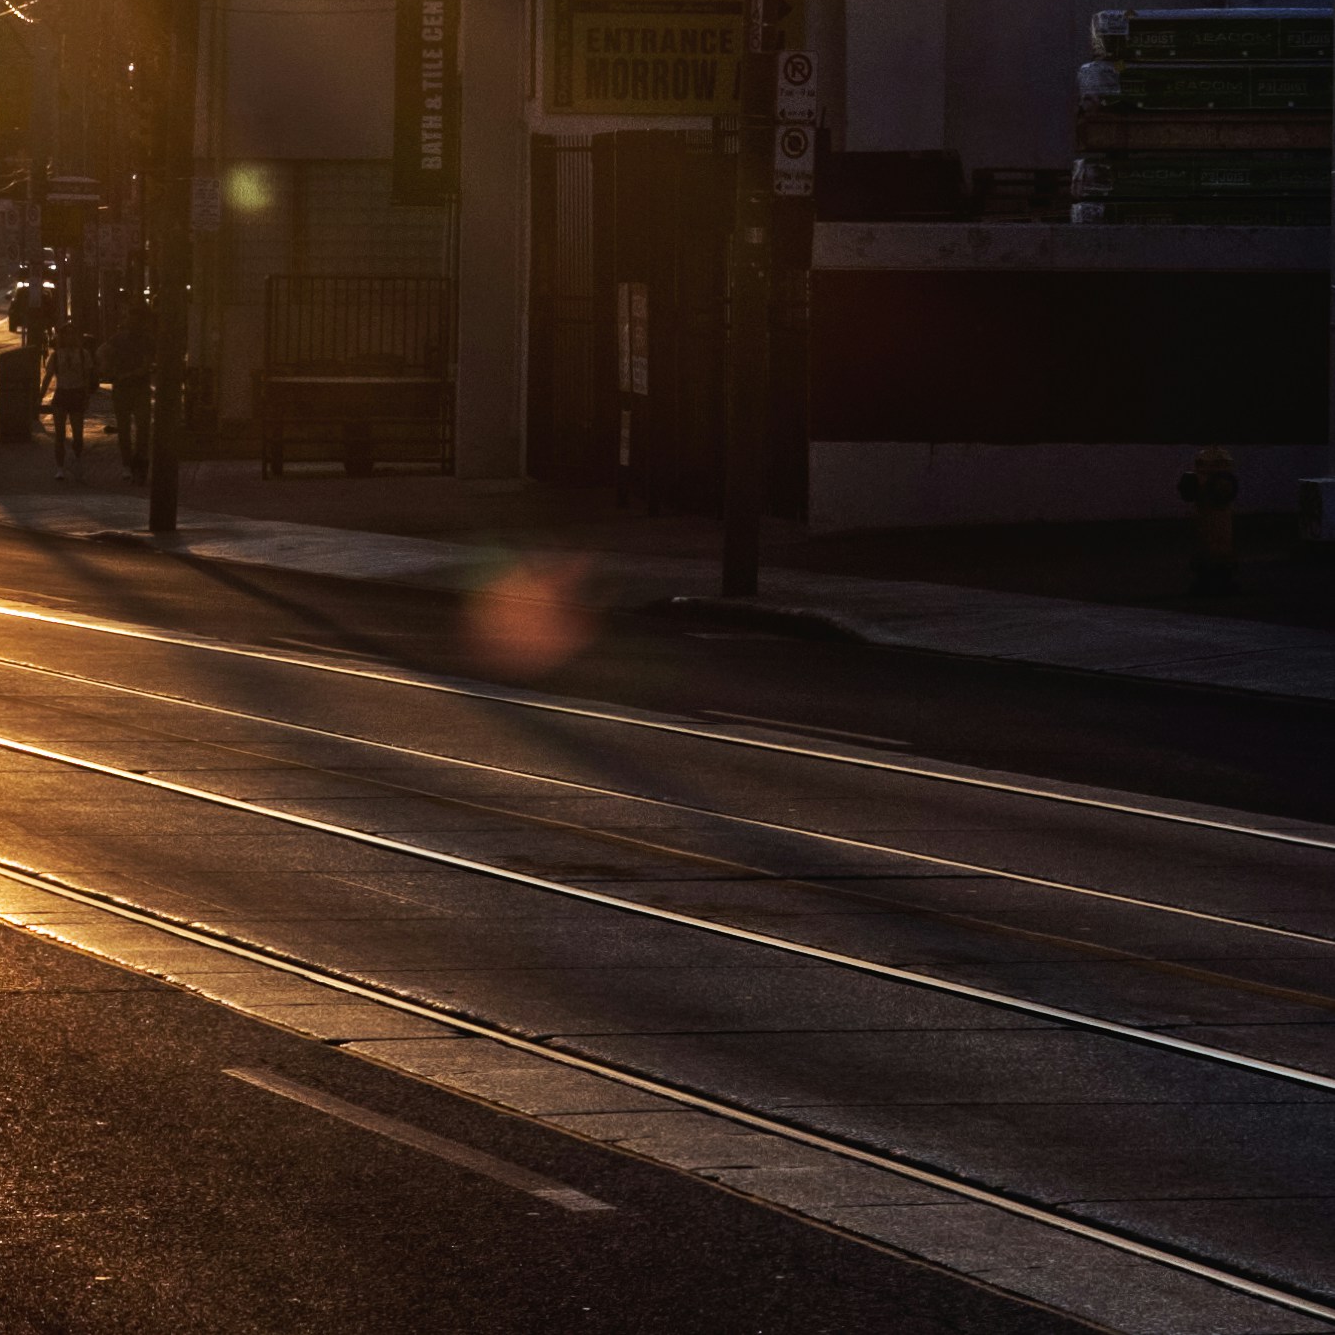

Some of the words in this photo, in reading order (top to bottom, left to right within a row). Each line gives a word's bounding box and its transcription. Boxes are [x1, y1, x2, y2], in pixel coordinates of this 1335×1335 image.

[586, 28, 734, 54] ENTRANCE
[1306, 34, 1331, 44] JOIS
[421, 48, 444, 91] TILE
[585, 58, 718, 100] MORROW
[423, 95, 443, 110] &
[421, 115, 443, 170] BATH
